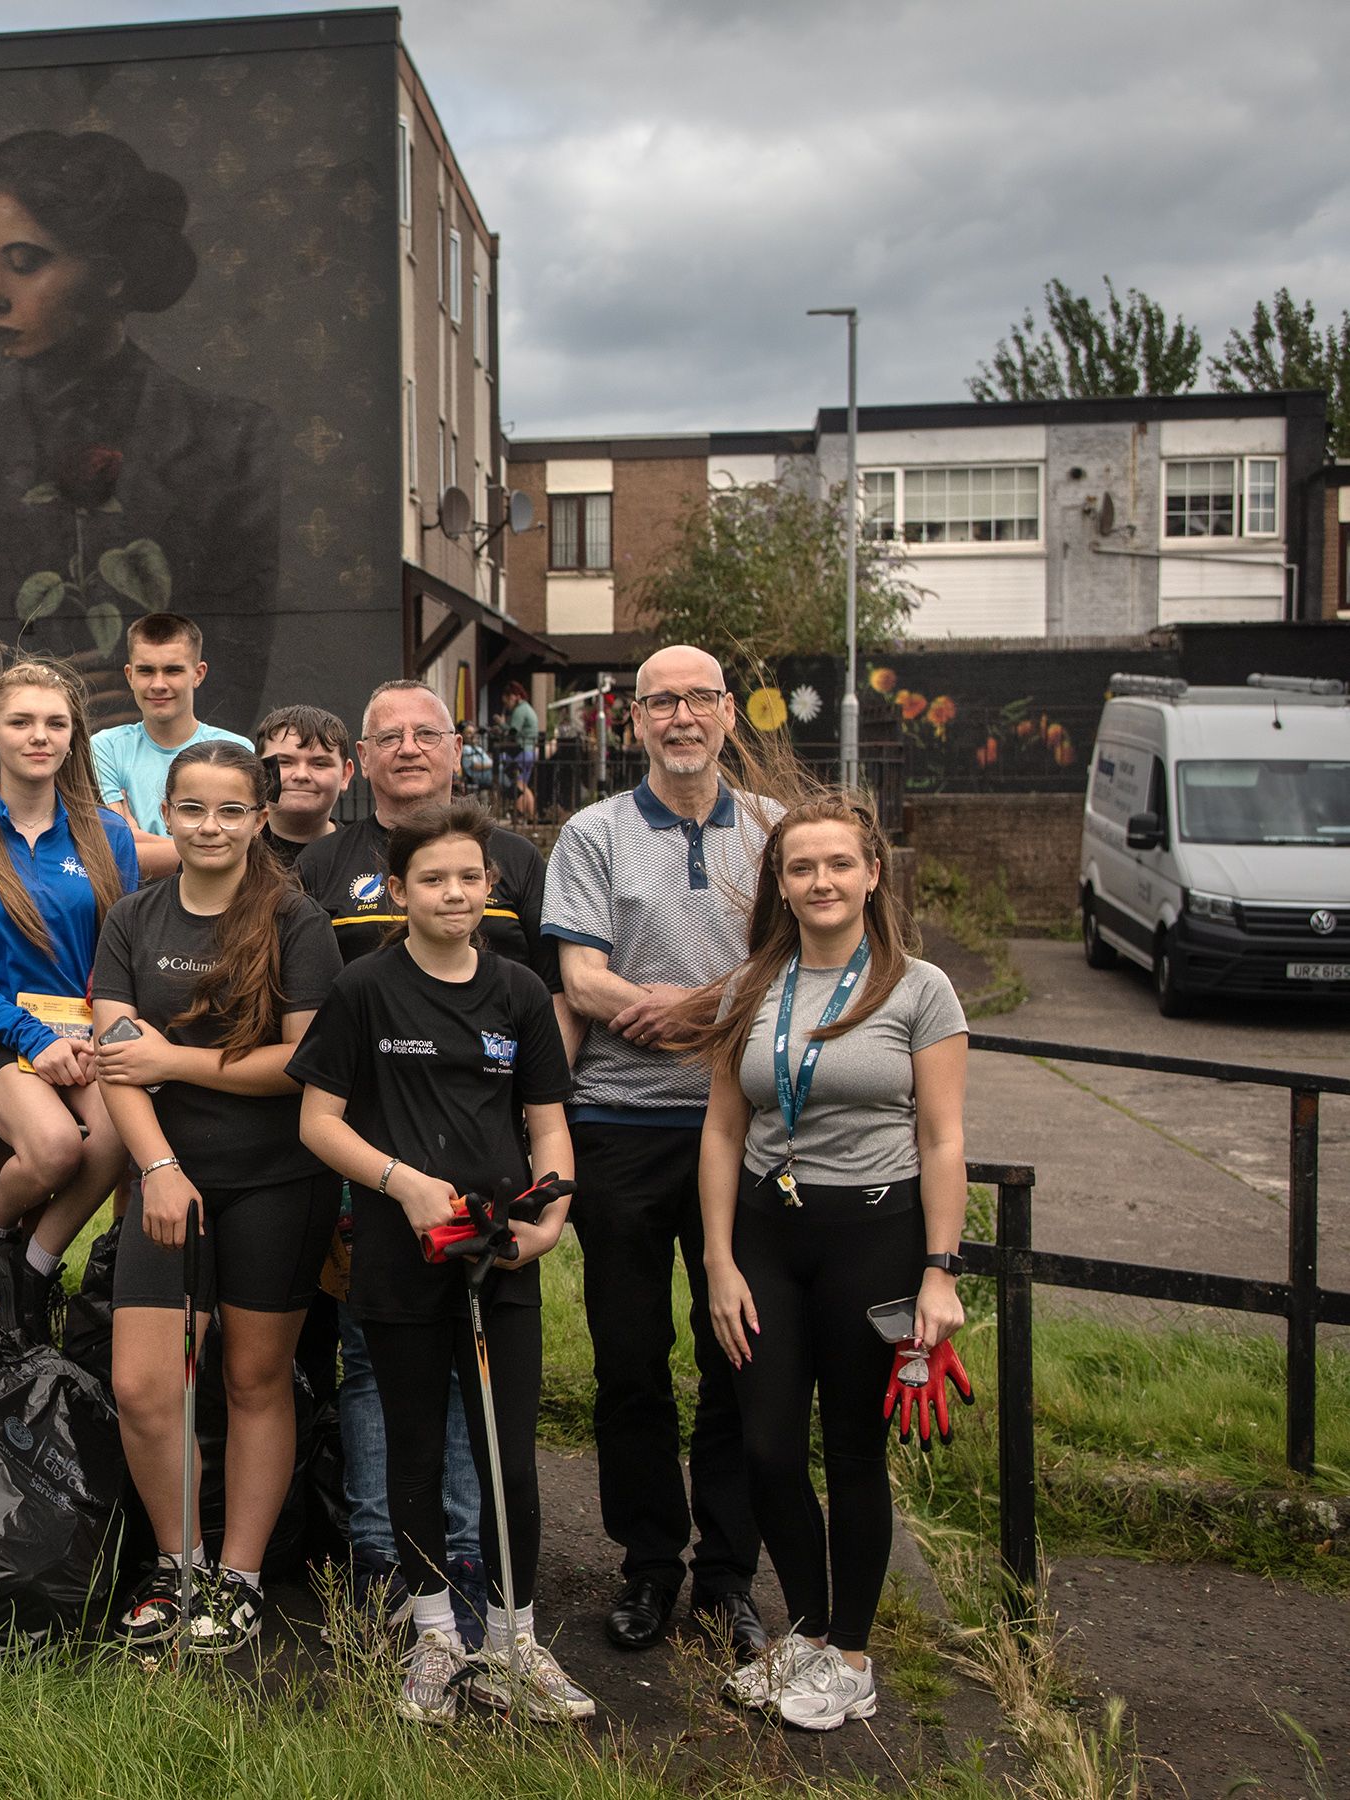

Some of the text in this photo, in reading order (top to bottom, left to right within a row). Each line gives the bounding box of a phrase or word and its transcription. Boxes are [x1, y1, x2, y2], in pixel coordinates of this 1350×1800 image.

[356, 901, 379, 912] STARS
[392, 1039, 434, 1048] CHAMPIONS
[392, 1046, 408, 1054] FOR
[43, 1457, 67, 1481] City
[29, 1477, 69, 1512] Services
